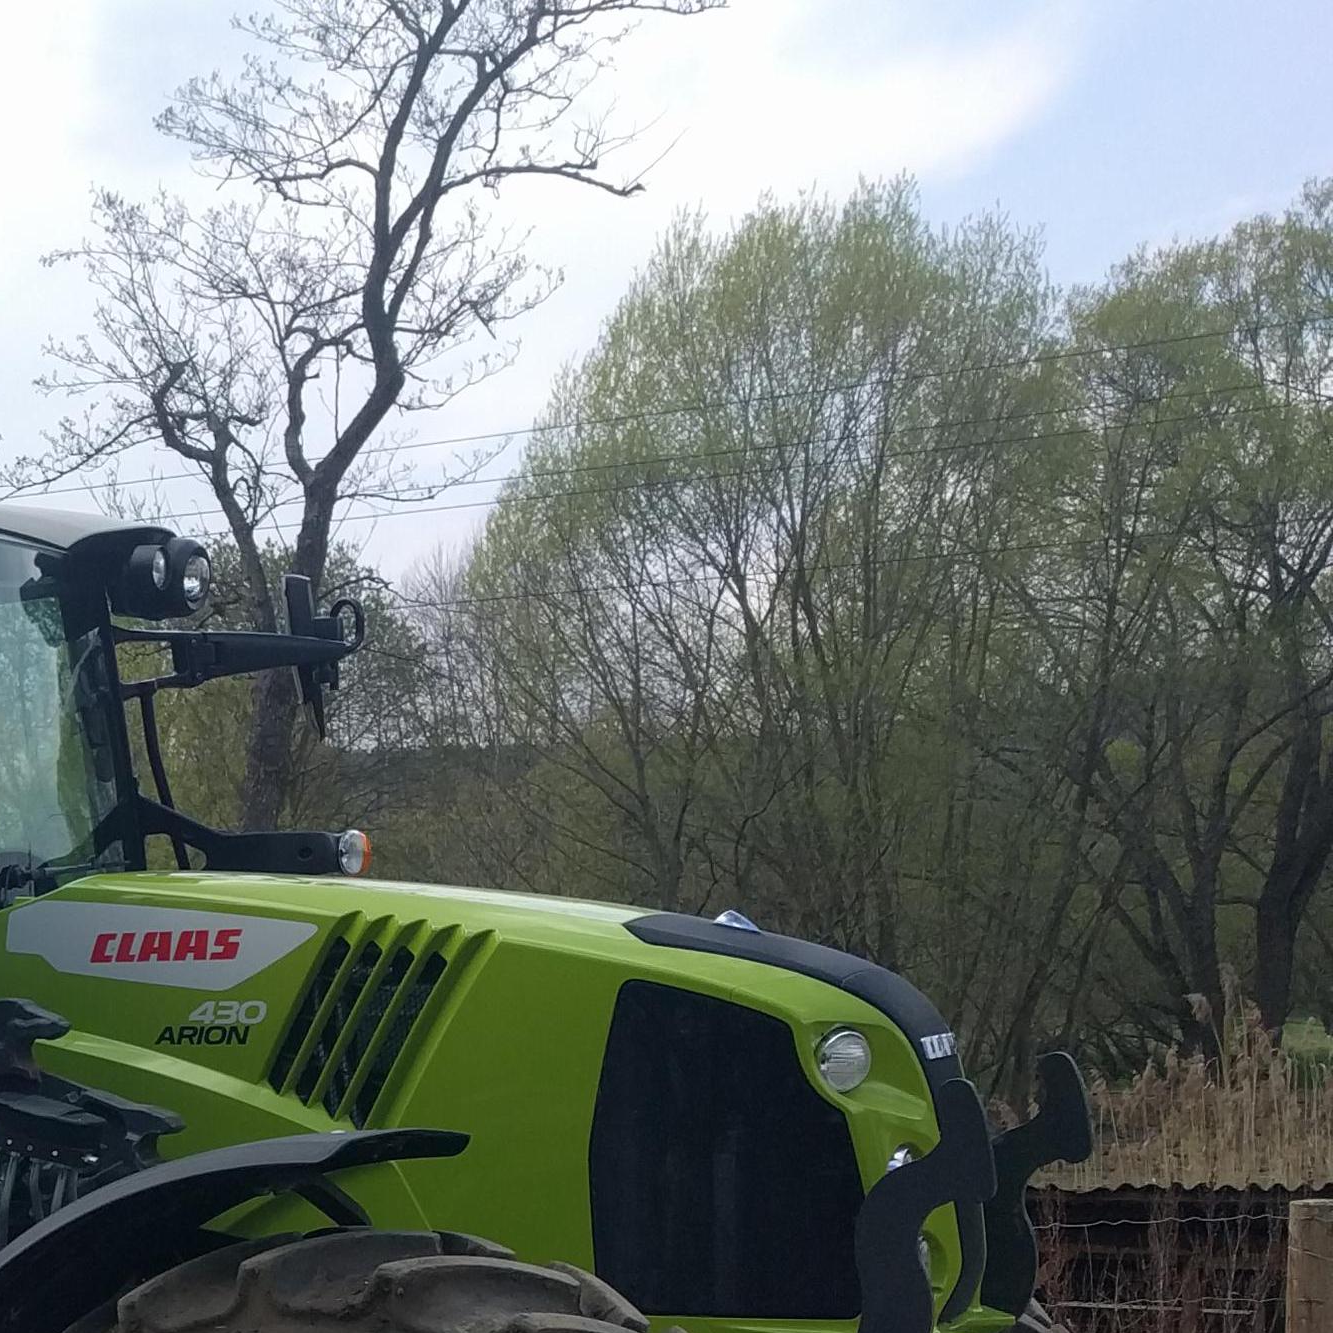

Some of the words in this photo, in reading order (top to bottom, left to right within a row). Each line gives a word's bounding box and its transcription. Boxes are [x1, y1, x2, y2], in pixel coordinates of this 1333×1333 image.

[89, 928, 243, 963] CLAAS
[188, 1000, 268, 1025] 430
[154, 1026, 250, 1046] ARION
